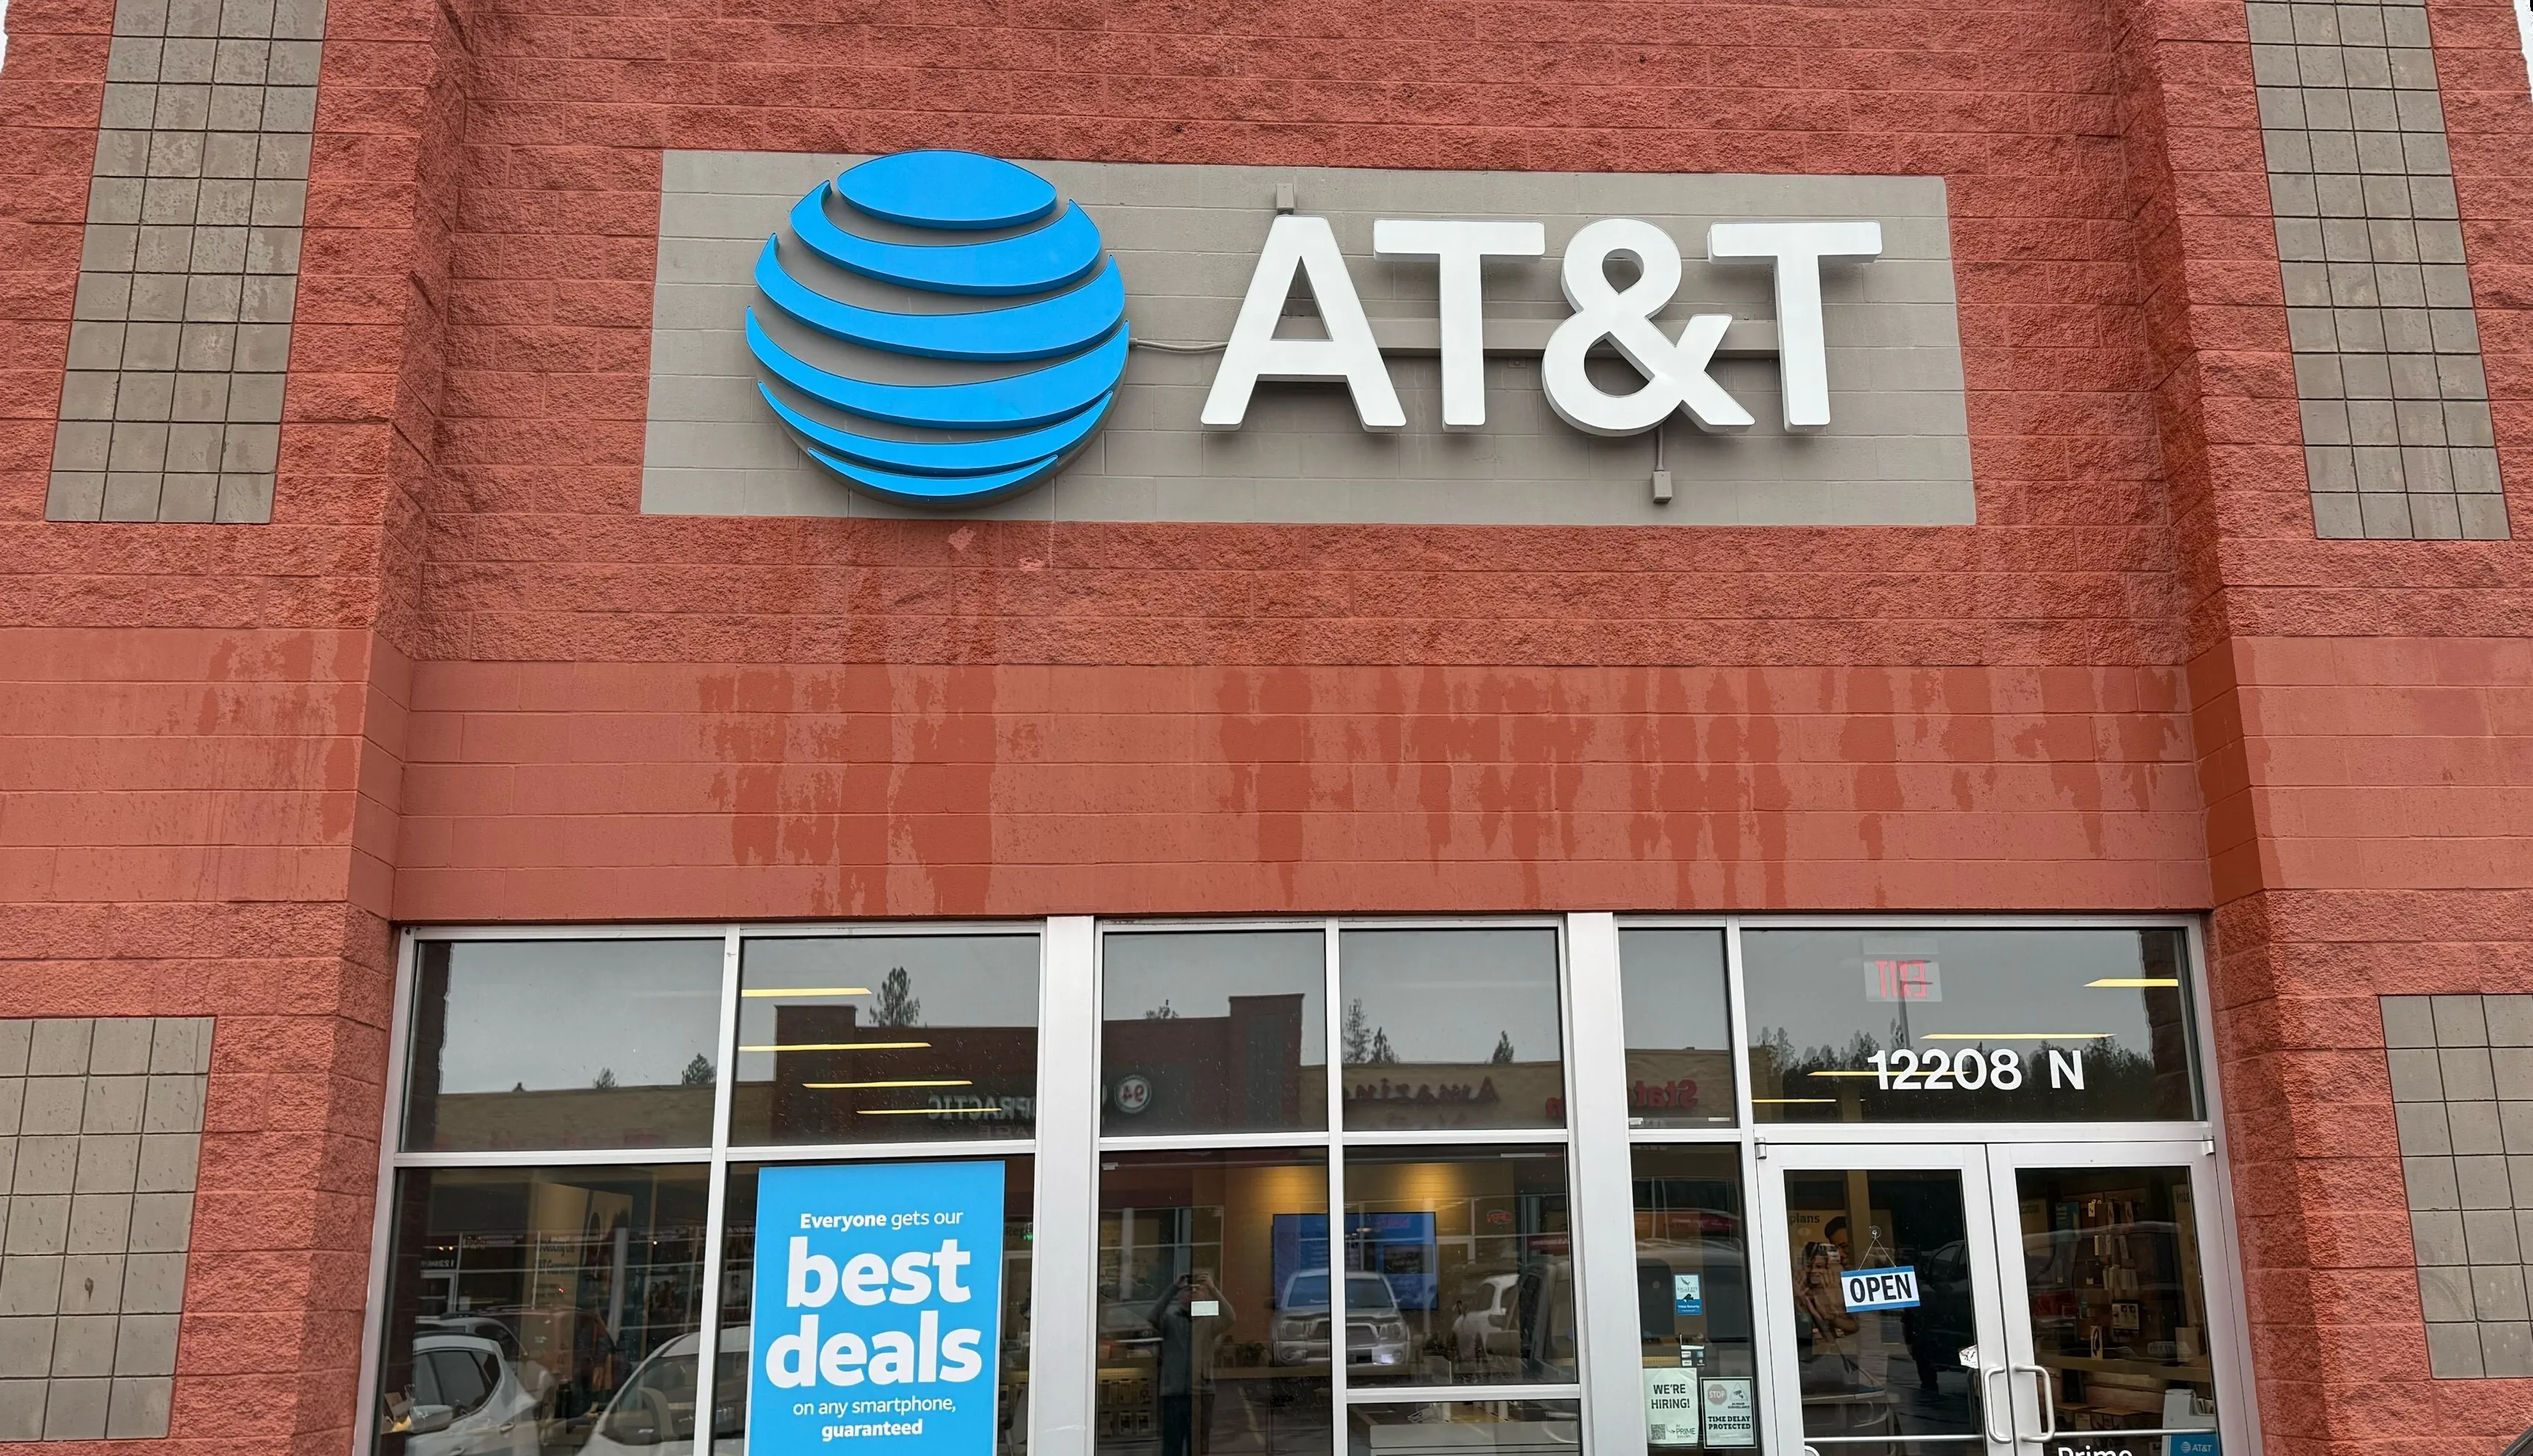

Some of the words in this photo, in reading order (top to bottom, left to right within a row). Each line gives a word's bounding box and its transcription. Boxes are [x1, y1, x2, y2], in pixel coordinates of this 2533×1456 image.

[1201, 215, 1883, 438] AT&T
[1867, 1048, 2022, 1090] 12208
[2049, 1049, 2085, 1090] N
[800, 1212, 887, 1232] Everyone
[891, 1211, 929, 1230] gets
[934, 1211, 964, 1225] our
[1789, 1212, 1820, 1225] plans
[786, 1236, 971, 1307] best
[1849, 1274, 1913, 1303] OPEN
[766, 1310, 982, 1388] deals
[1653, 1384, 1686, 1394] WE'RE
[1709, 1390, 1725, 1399] STOP
[792, 1402, 814, 1416] on
[818, 1401, 848, 1418] any
[852, 1396, 956, 1416] smartphone,
[1651, 1398, 1690, 1409] HIRING!
[822, 1418, 923, 1442] guaranteed
[2192, 1444, 2212, 1452] AT&T
